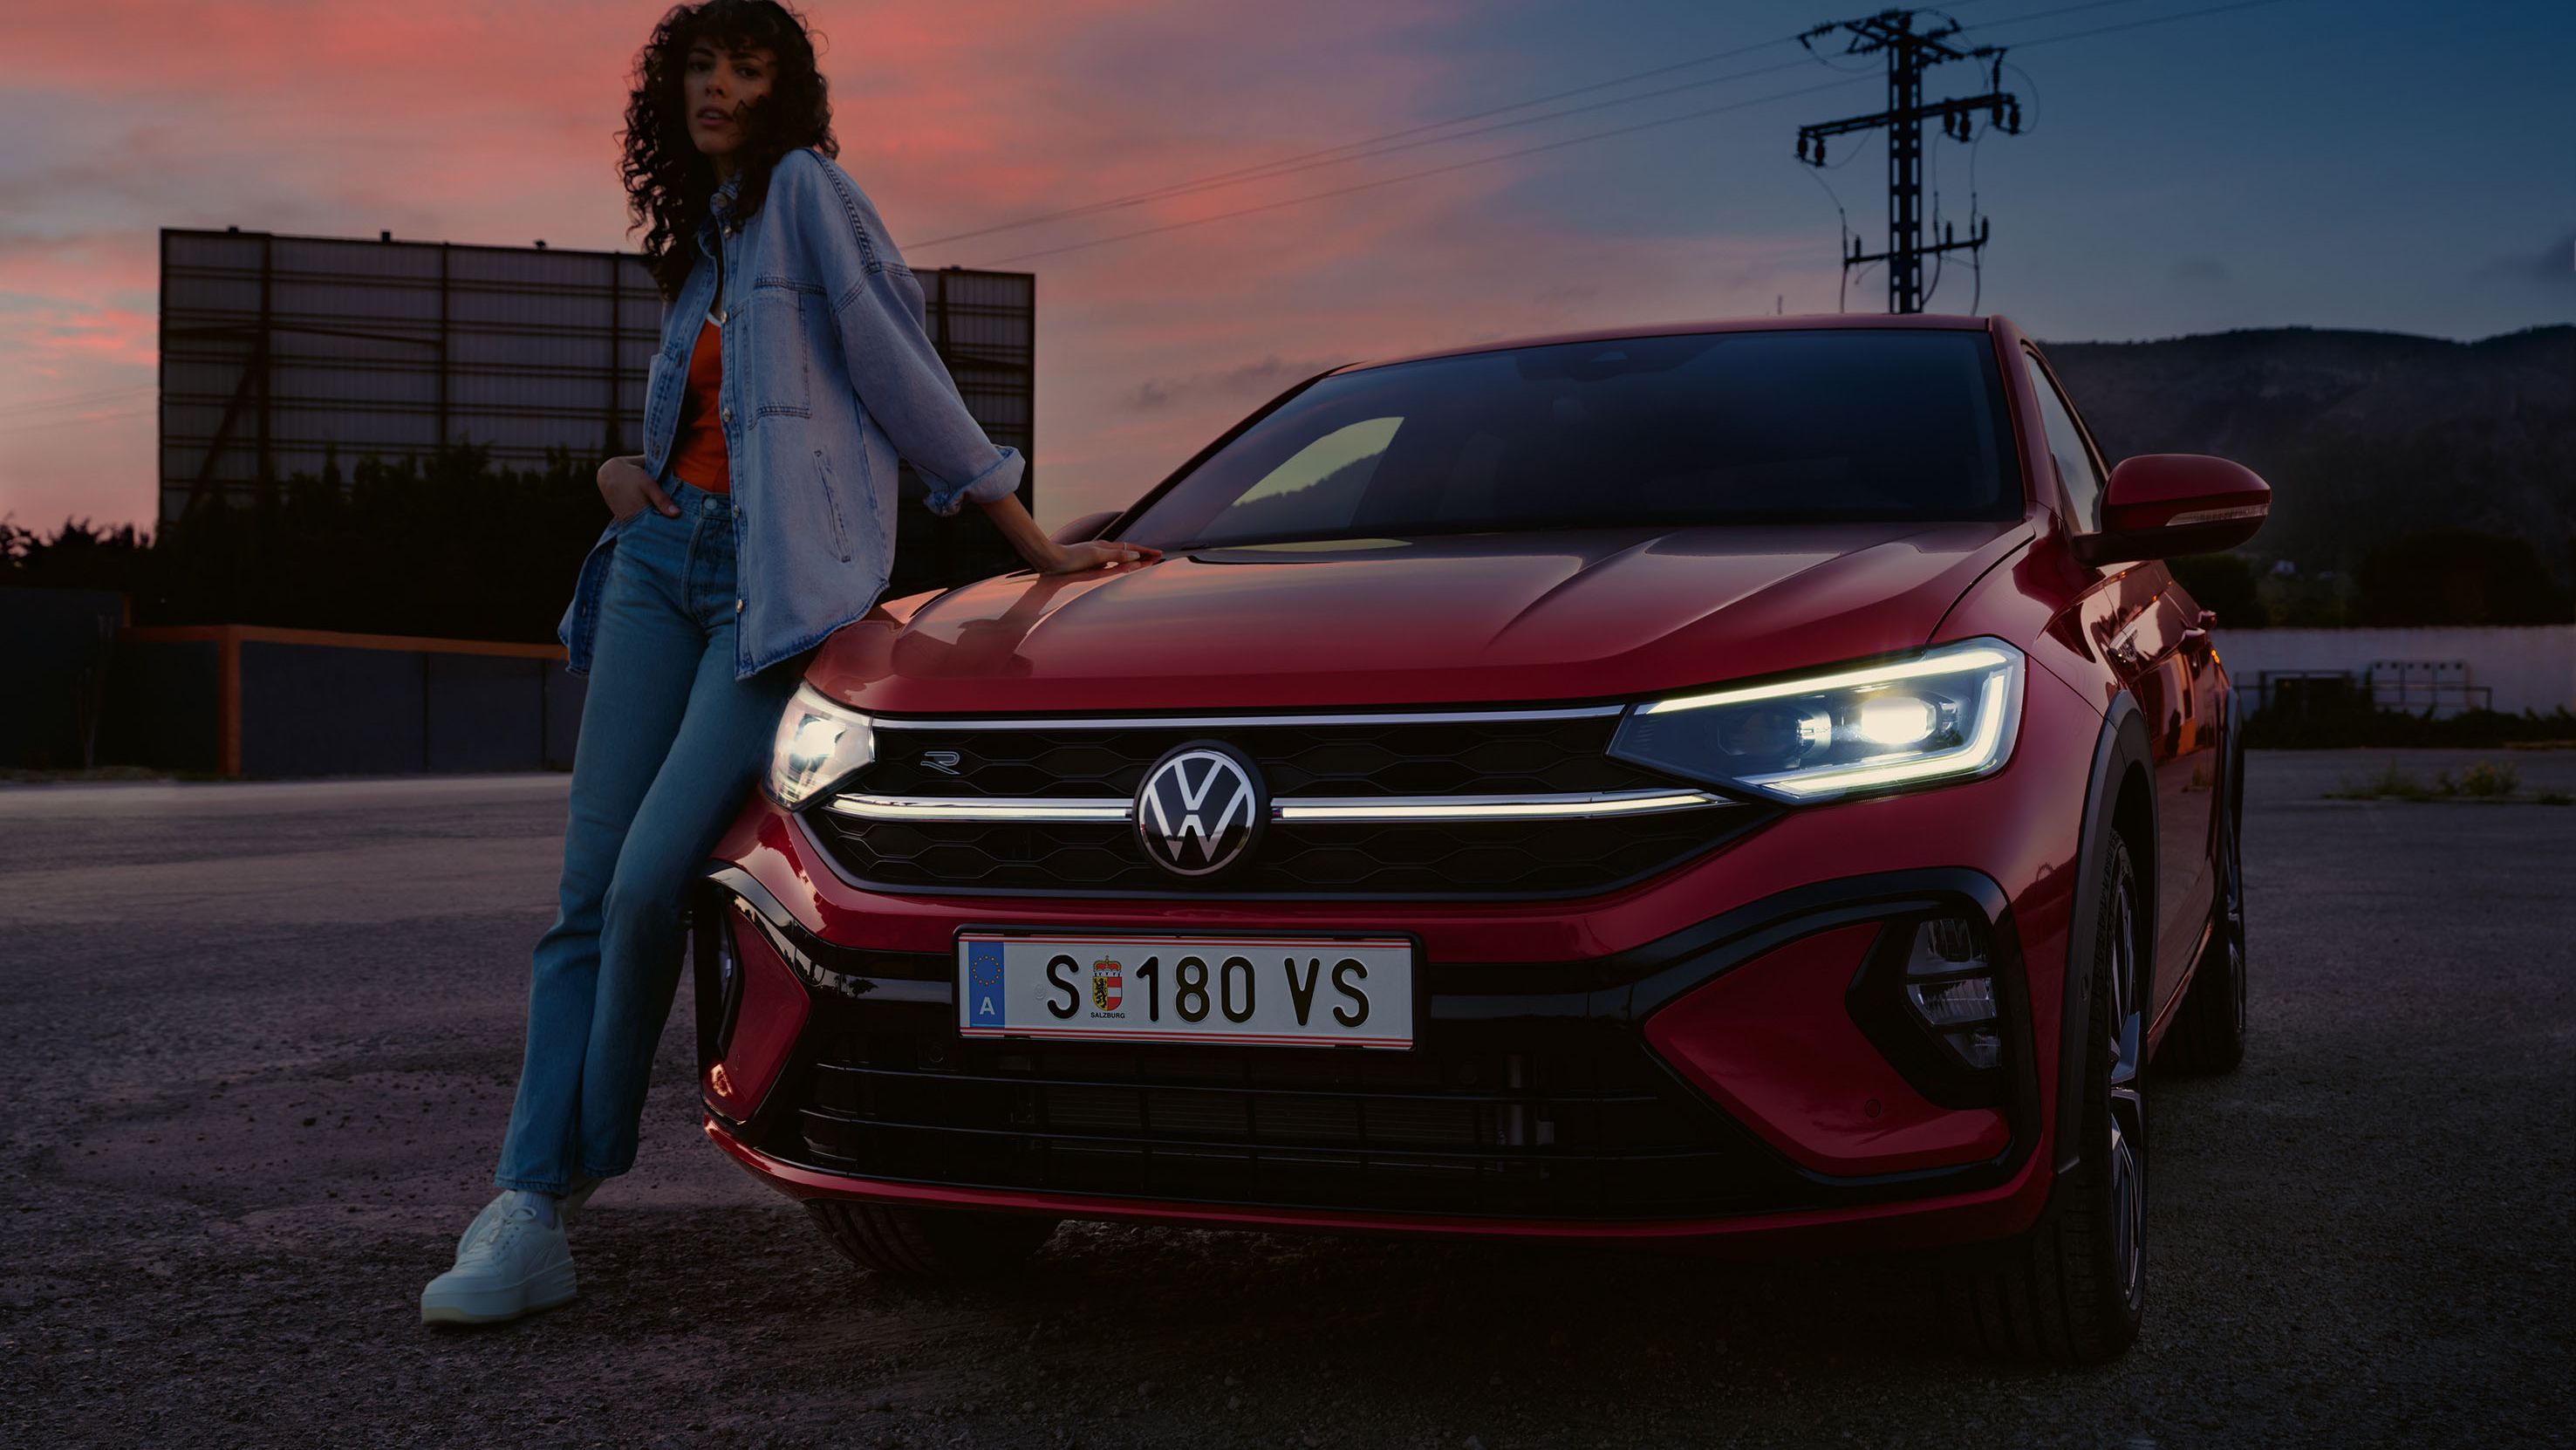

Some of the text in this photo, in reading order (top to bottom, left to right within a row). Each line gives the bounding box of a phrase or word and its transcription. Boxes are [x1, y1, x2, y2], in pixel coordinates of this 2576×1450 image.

[979, 996, 995, 1016] A
[1047, 954, 1370, 1028] S 180 VS
